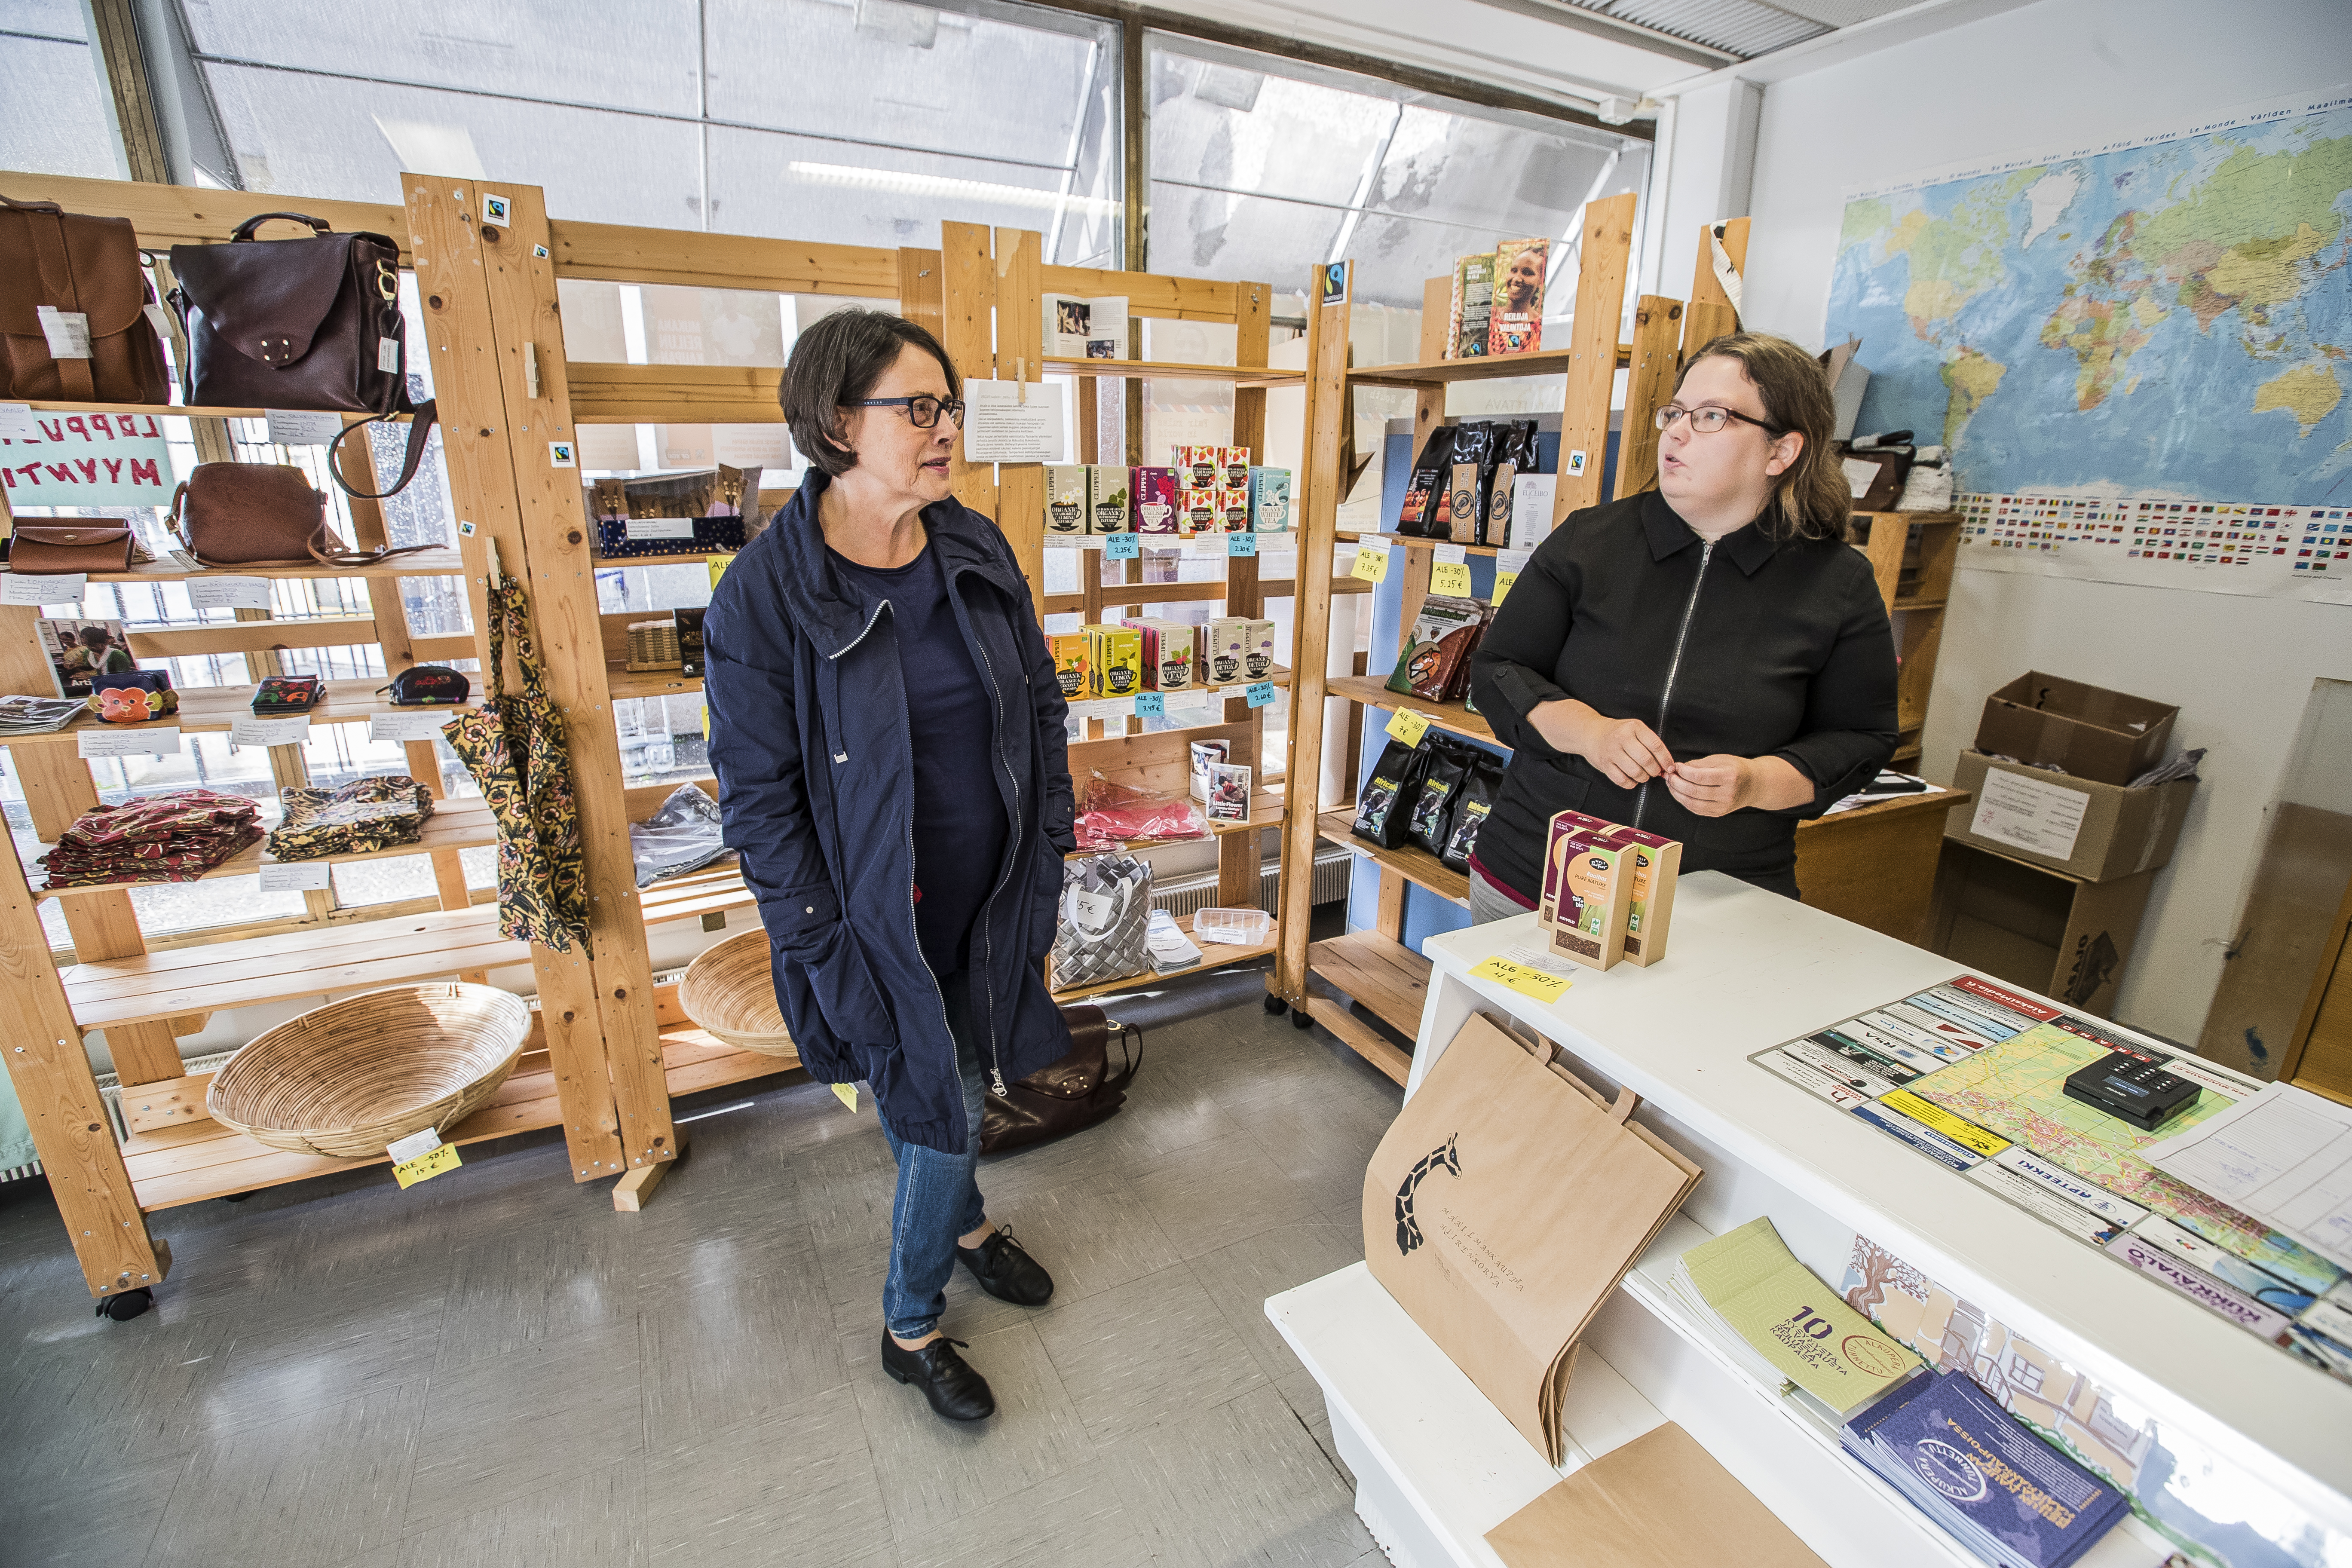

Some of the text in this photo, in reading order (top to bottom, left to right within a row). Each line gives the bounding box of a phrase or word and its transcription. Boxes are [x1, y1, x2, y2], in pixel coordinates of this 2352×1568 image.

[2307, 98, 2352, 111] Maailma
[2251, 108, 2292, 121] Världen
[2204, 119, 2236, 132] Monde
[2144, 132, 2177, 143] Verden
[1324, 293, 1342, 302] FAIRTRADE
[1504, 312, 1528, 321] REILUJA
[1500, 323, 1531, 332] VALINTOJA
[1122, 536, 1136, 544] -30%
[1451, 567, 1465, 579] -30%
[1499, 577, 1513, 586] ALE
[1397, 711, 1425, 733] ALE -30%
[1591, 861, 1608, 870] Partner
[1586, 871, 1607, 882] Rooibos
[1588, 877, 1607, 888] NATURE
[1087, 904, 1096, 915] €
[1559, 916, 1575, 924] HEIVELD
[1490, 962, 1563, 987] ALE -30%
[1964, 980, 2049, 1014] AleksiMedia.fi
[1946, 995, 1994, 1015] LVI-palvelu
[1991, 1014, 2025, 1028] Raahen
[1860, 1032, 1898, 1048] RSA
[2063, 1025, 2146, 1061] CRAMO
[1799, 1051, 1823, 1062] LAITE
[1821, 1063, 1855, 1078] RENGAS
[2187, 1070, 2230, 1089] MUURAUS
[1829, 1084, 1863, 1101] verhoilu
[1976, 1129, 2001, 1141] 08-221
[1924, 1132, 1975, 1158] KEITTIÖKEIDAS
[1912, 1142, 1960, 1168] KOTIMAISET
[398, 1162, 418, 1174] ALE
[416, 1167, 427, 1176] 15
[2005, 1175, 2034, 1190] MAJAVA
[2016, 1160, 2092, 1199] APTEEKKI
[1441, 1207, 1524, 1292] MAAILMANKAUPPA
[2122, 1246, 2265, 1321] KUKKATALO
[1792, 1305, 1833, 1340] 10
[1775, 1324, 1816, 1360] REILUSTA
[1784, 1318, 1839, 1363] KYSYMYSTÄ
[1769, 1327, 1819, 1370] KAUPASTA
[1847, 1343, 1883, 1375] TUNNETTU
[1927, 1443, 1978, 1482] TUNNETTU
[1966, 1452, 2021, 1494] KAUPAN
